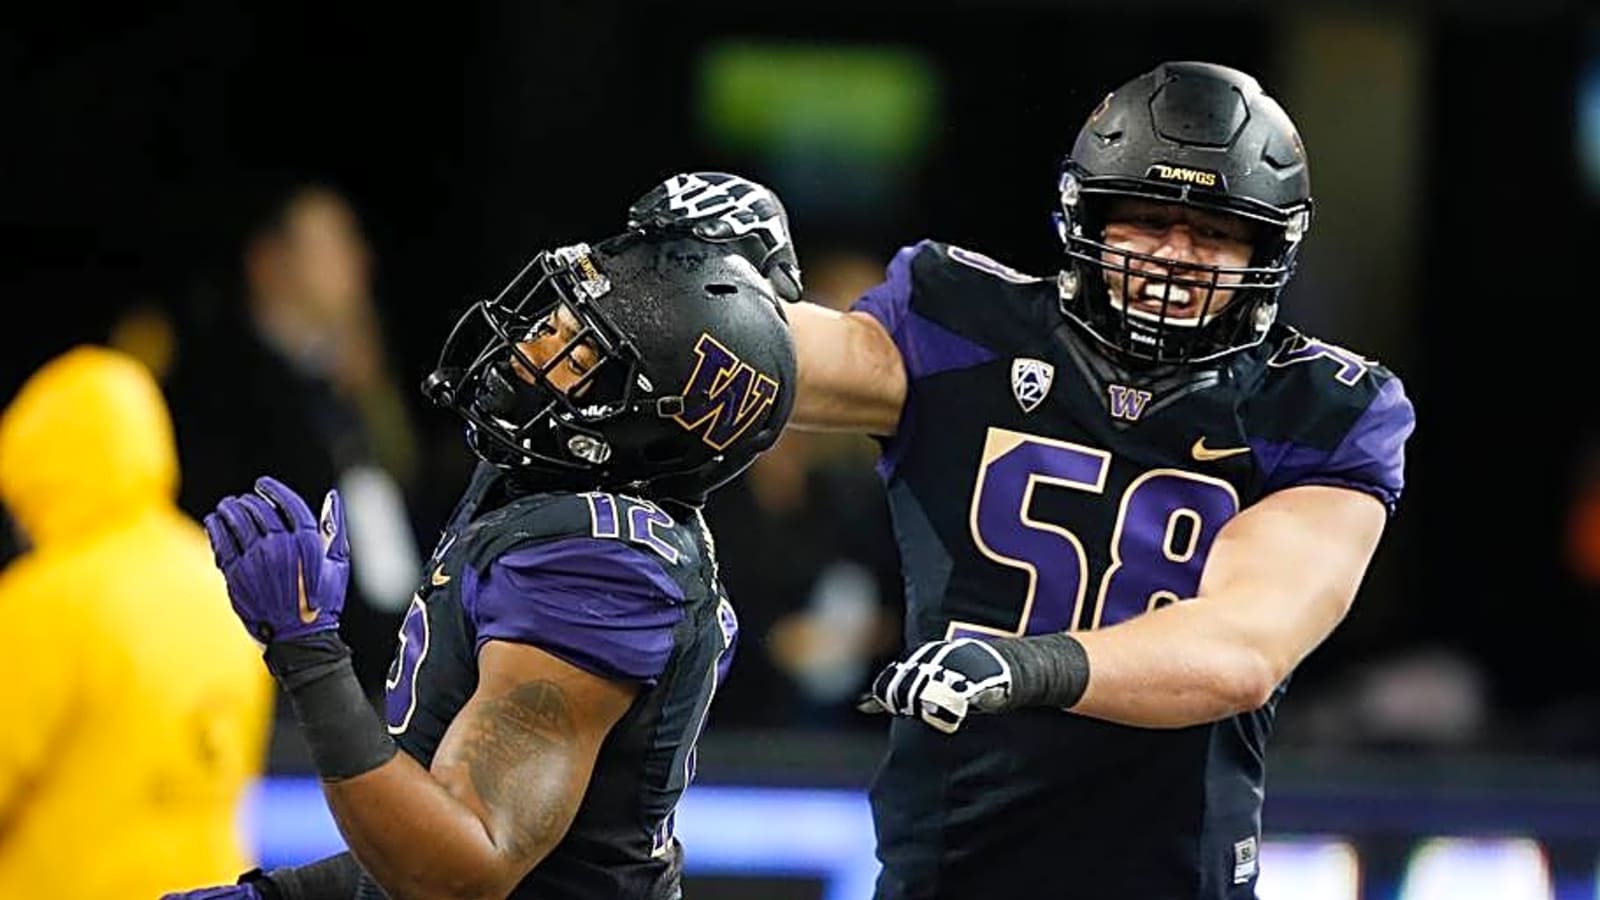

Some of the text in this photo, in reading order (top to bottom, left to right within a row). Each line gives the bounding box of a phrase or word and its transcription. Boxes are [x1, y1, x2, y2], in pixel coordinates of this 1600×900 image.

[1159, 165, 1217, 187] DAWGS
[674, 332, 779, 450] W
[1108, 384, 1153, 420] W
[576, 491, 679, 565] 12
[945, 426, 1240, 641] 58
